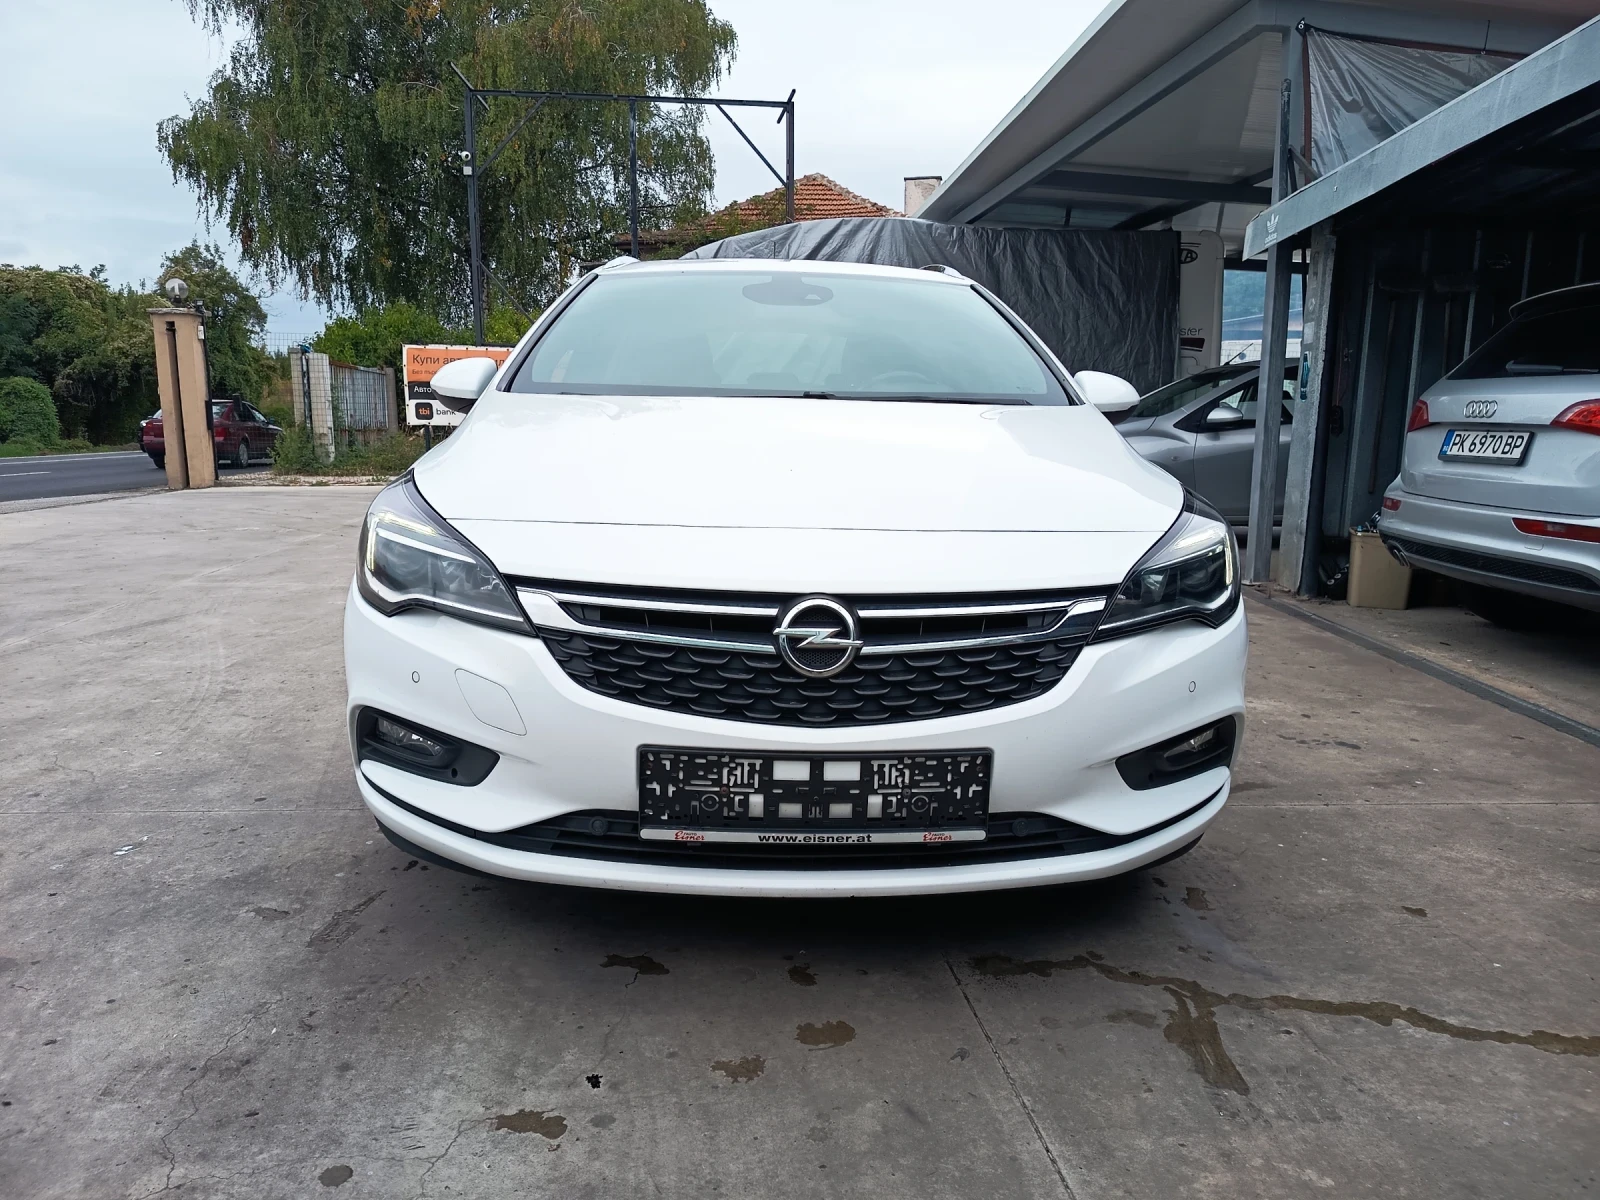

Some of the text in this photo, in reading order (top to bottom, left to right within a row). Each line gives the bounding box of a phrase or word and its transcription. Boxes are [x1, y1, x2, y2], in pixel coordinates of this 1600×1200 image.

[1264, 232, 1277, 244] adidas
[412, 354, 440, 366] Купи
[413, 385, 432, 393] Авто
[418, 407, 456, 416] tbi bank
[1468, 434, 1502, 453] 6970
[758, 834, 872, 843] www.eisner.at
